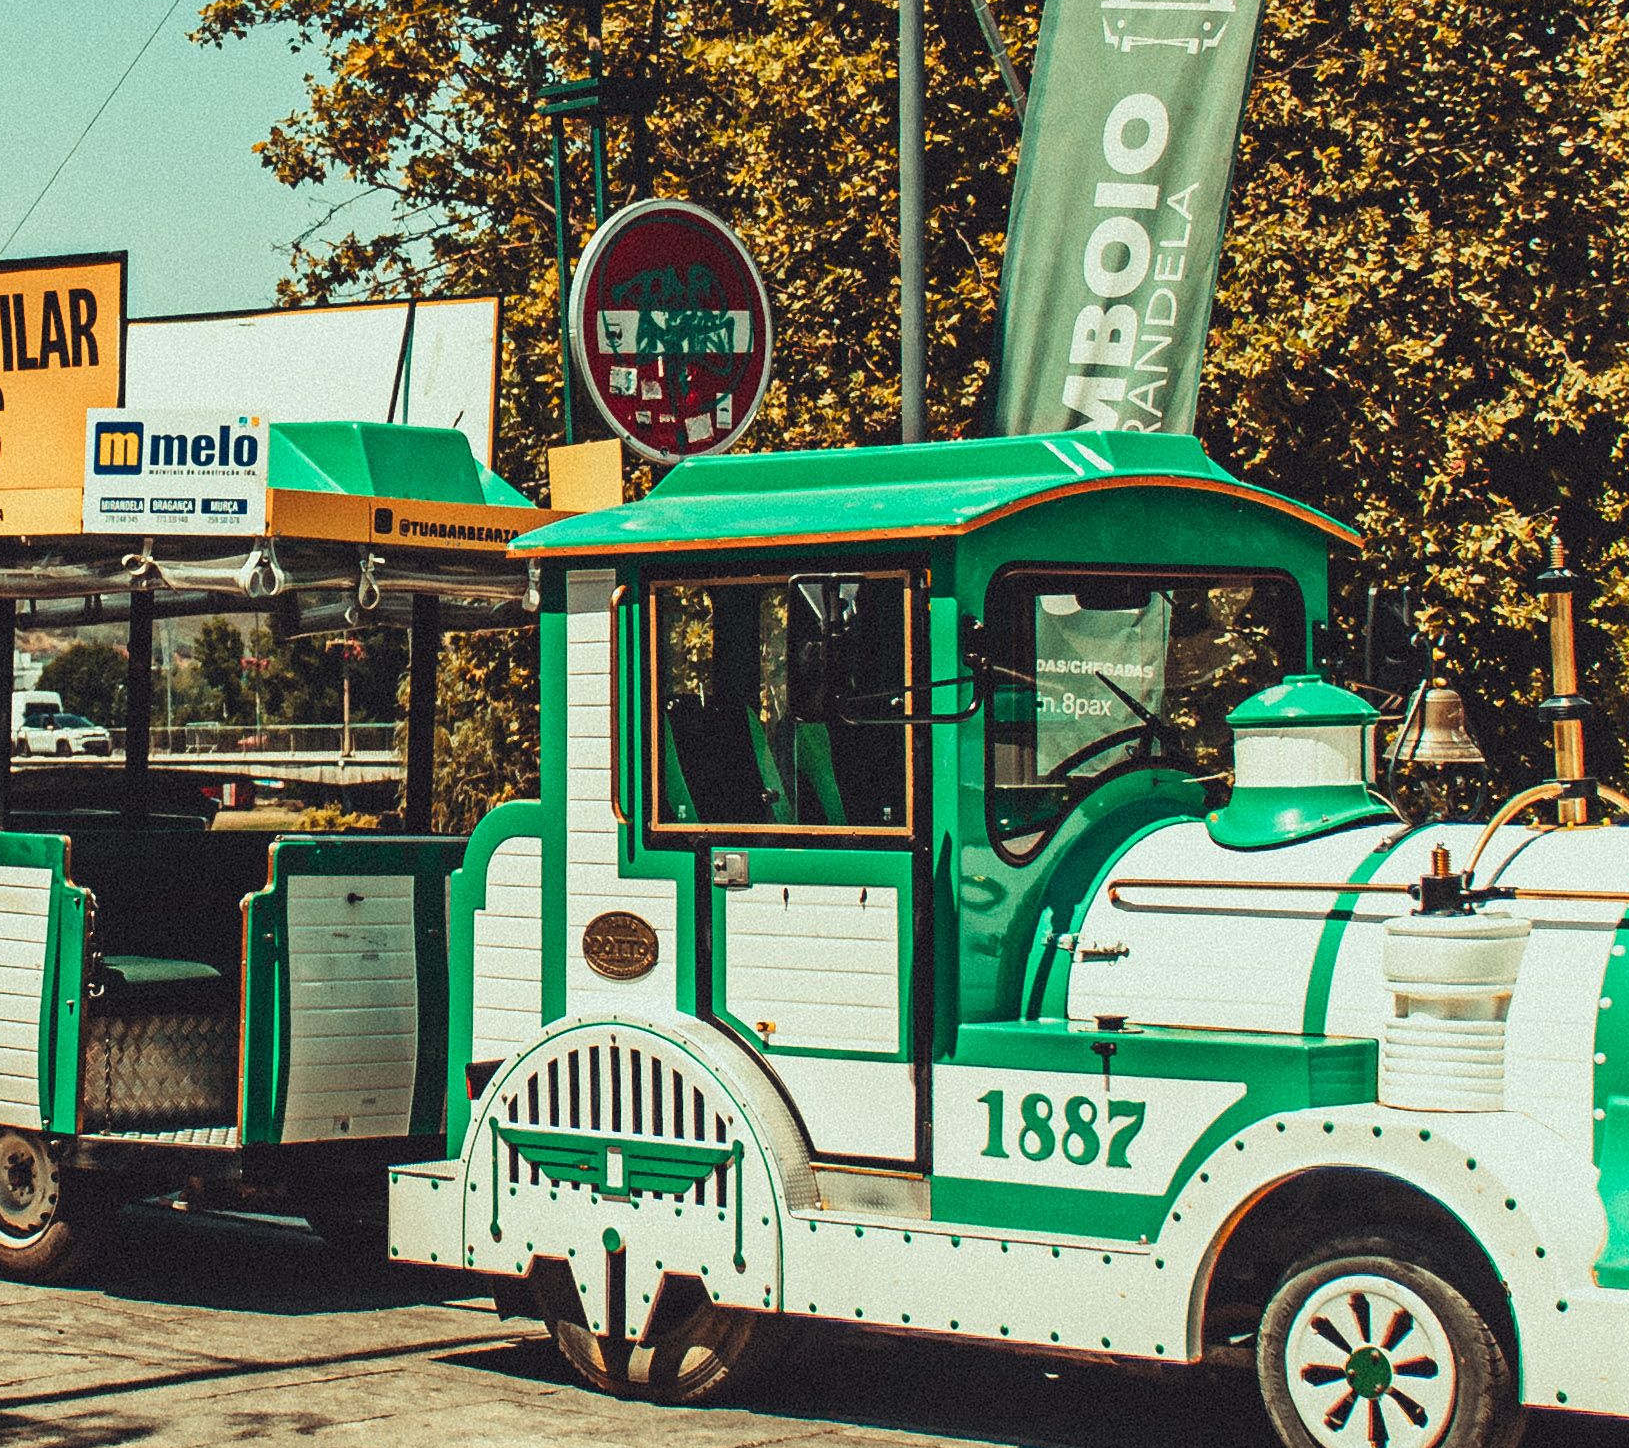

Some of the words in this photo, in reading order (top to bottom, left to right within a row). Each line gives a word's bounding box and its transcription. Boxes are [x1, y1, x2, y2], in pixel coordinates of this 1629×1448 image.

[150, 425, 258, 467] melo
[101, 499, 144, 512] MIRANDELA
[152, 499, 193, 514] BRAGANÇA
[210, 499, 239, 514] MURÇA
[976, 1089, 1146, 1170] 1887
